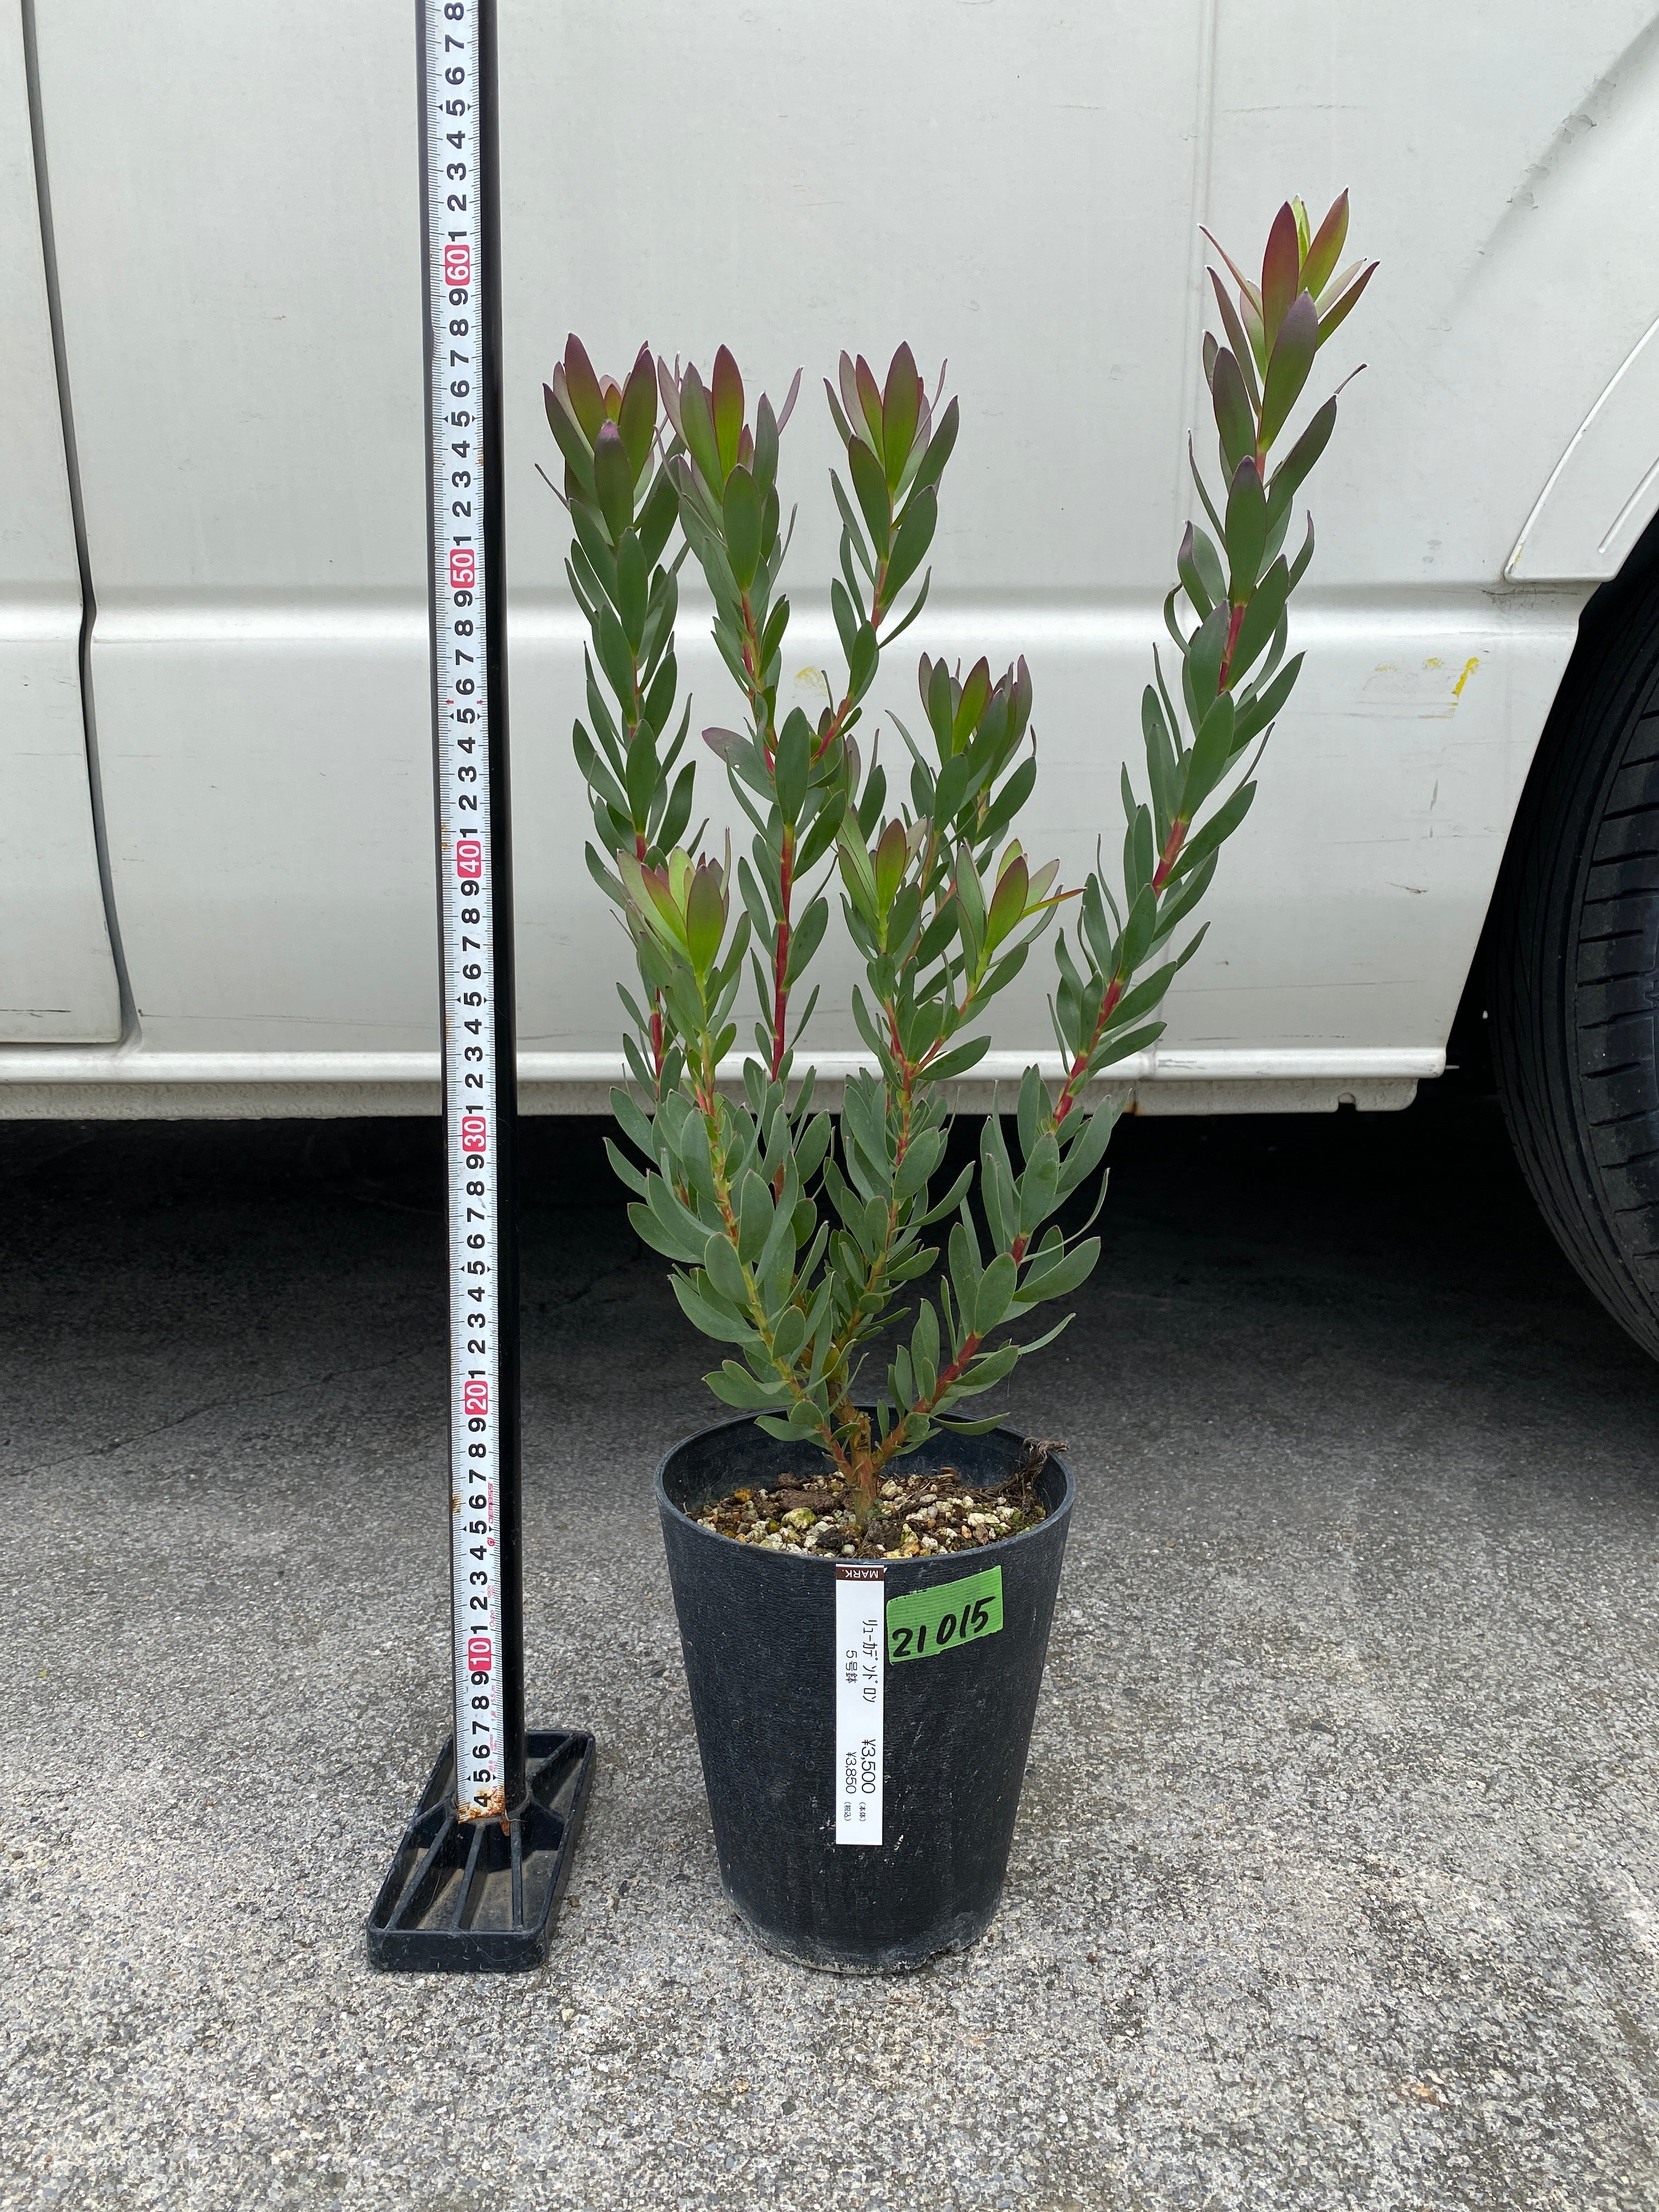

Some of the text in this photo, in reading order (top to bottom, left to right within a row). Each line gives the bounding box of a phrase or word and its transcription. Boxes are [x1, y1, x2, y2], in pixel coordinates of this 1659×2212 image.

[444, 3, 491, 1808] 4 5 6 7 8 9 10 1 2 3 4 5 6 7 8 9 20 1 2 3 4 5 6 7 8 9 30 1 2 3 4 5 6 7 8 9 40 1 2 3 4 5 6 7 8 9 50 1 2 3 4 5 6 7 8 9 60 1 2 3 4 5 6 7 8
[845, 1649, 857, 1684] 5号鉢
[845, 1751, 857, 1794] ¥3,850
[861, 1739, 876, 1793] ¥3,500
